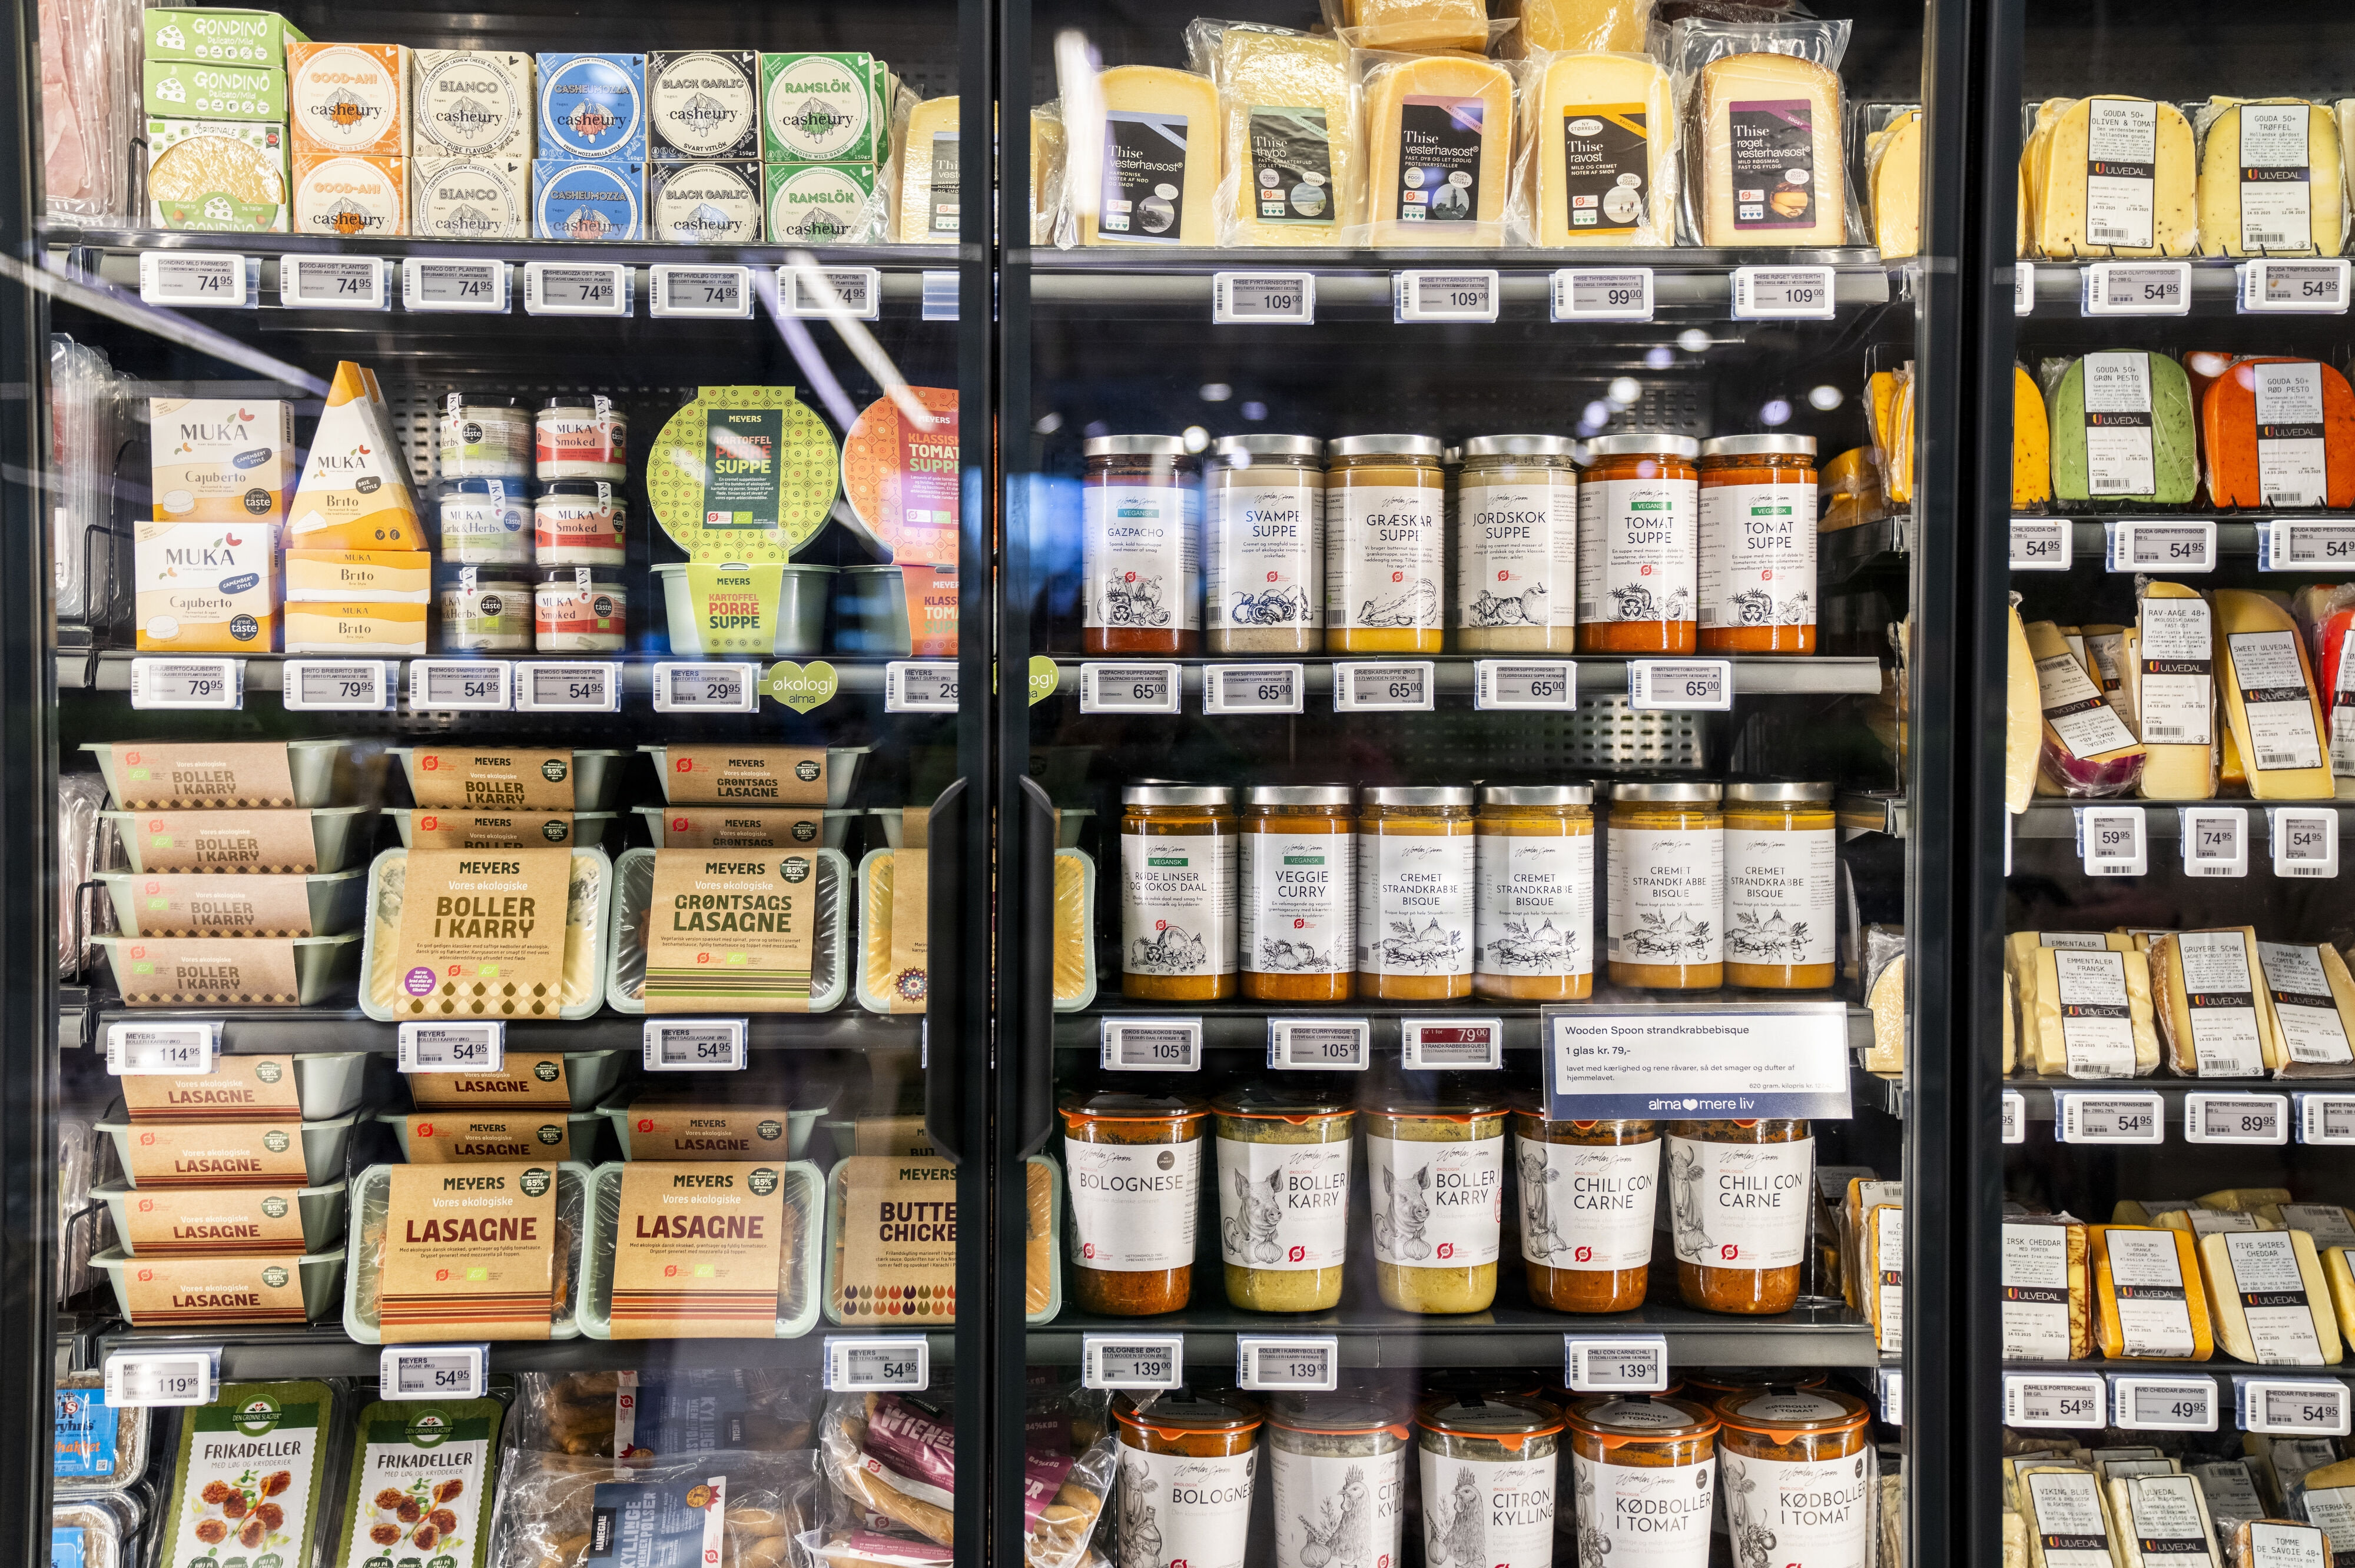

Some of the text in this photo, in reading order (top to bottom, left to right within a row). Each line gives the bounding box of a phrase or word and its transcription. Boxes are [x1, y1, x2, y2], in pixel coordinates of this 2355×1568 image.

[194, 18, 268, 37] GONDINO
[208, 37, 254, 45] Delicato/Mild
[311, 73, 377, 84] GOOD-AH!
[662, 79, 743, 89] BLACK GARLIC
[440, 81, 498, 94] BIANCO
[554, 84, 629, 95] CASHEUMOZZA
[785, 80, 851, 94] RAMSLÖK
[311, 102, 382, 119] casheury
[669, 108, 738, 122] casheury
[1618, 118, 1637, 130] RAVOST
[1787, 116, 1803, 127] RØGET
[684, 141, 727, 152] SVART VITLÖK
[1254, 135, 1287, 148] Thise
[1568, 140, 1603, 152] Thise
[1737, 138, 1763, 150] røget
[446, 142, 493, 154] PURE FLAVOUR
[1256, 147, 1286, 159] thybo
[1570, 151, 1603, 162] ravost
[2107, 166, 2146, 176] ULVEDAL
[556, 424, 592, 434] MUKA
[555, 436, 595, 447] Smoked
[716, 436, 772, 444] KARTOFFEL
[715, 446, 771, 459] PORRE
[715, 459, 771, 474] SUPPE
[326, 496, 358, 507] Brito
[1246, 510, 1302, 523] SVAMPE
[1366, 515, 1432, 527] GRÆSKAR
[1472, 511, 1546, 524] JORDSKOK
[1107, 528, 1163, 538] GAZPACHO
[1744, 521, 1793, 534] TOMAT
[1747, 537, 1792, 549] SUPPE
[165, 549, 234, 566] MUKA
[223, 577, 253, 589] CAMEMBERT
[170, 597, 232, 609] Cajuberto
[232, 623, 257, 632] taste
[773, 677, 832, 692] økologi
[789, 693, 815, 704] alma
[460, 862, 520, 875] MEYERS
[1135, 872, 1199, 881] RØDE LINSER
[1275, 871, 1329, 883] VEGGIE
[1400, 873, 1442, 882] CREMET
[449, 881, 528, 891] Vores økologiske
[1178, 883, 1207, 892] DAAL
[1278, 886, 1326, 898] CURRY
[436, 896, 535, 917] BOLLER
[675, 895, 792, 911] GRØNTSAGS
[1402, 896, 1440, 906] BISQUE
[434, 919, 535, 938] I KARRY
[674, 912, 791, 933] LASAGNE
[1565, 1025, 1749, 1037] Wooden Spoon strandkrabbebisque
[1573, 1046, 1594, 1057] glas
[1597, 1046, 1610, 1055] kr.
[1613, 1046, 1631, 1057] 79,-
[1604, 1065, 1640, 1073] kærlighed
[1671, 1064, 1698, 1072] råvarer,
[1567, 1074, 1614, 1083] hjemmelavet.
[1648, 1098, 1754, 1109] alma mere liv
[443, 1177, 505, 1191] MEYERS
[1080, 1172, 1183, 1191] BOLOGNESE
[1289, 1174, 1345, 1191] BOLLER
[1574, 1172, 1652, 1192] CHILI CON
[1288, 1192, 1339, 1208] KARRY
[1574, 1192, 1634, 1210] CARNE
[880, 1202, 956, 1222] BUTTE
[406, 1217, 537, 1243] LASAGNE
[880, 1224, 956, 1243] CHICKE
[173, 1294, 260, 1308] LASAGNE
[204, 1441, 301, 1460] FRIKADELLER
[253, 1459, 291, 1467] KRYDDERIER
[1492, 1488, 1550, 1508] CITRON
[1780, 1480, 1866, 1508] KØDBOLLER
[2039, 1488, 2067, 1496] VIKING
[1493, 1504, 1553, 1526] KYLLING
[1782, 1506, 1850, 1525] I TOMAT
[2275, 1537, 2300, 1546] TOMME
[2268, 1547, 2301, 1557] SAVOIE
[2305, 1549, 2320, 1557] 48+
